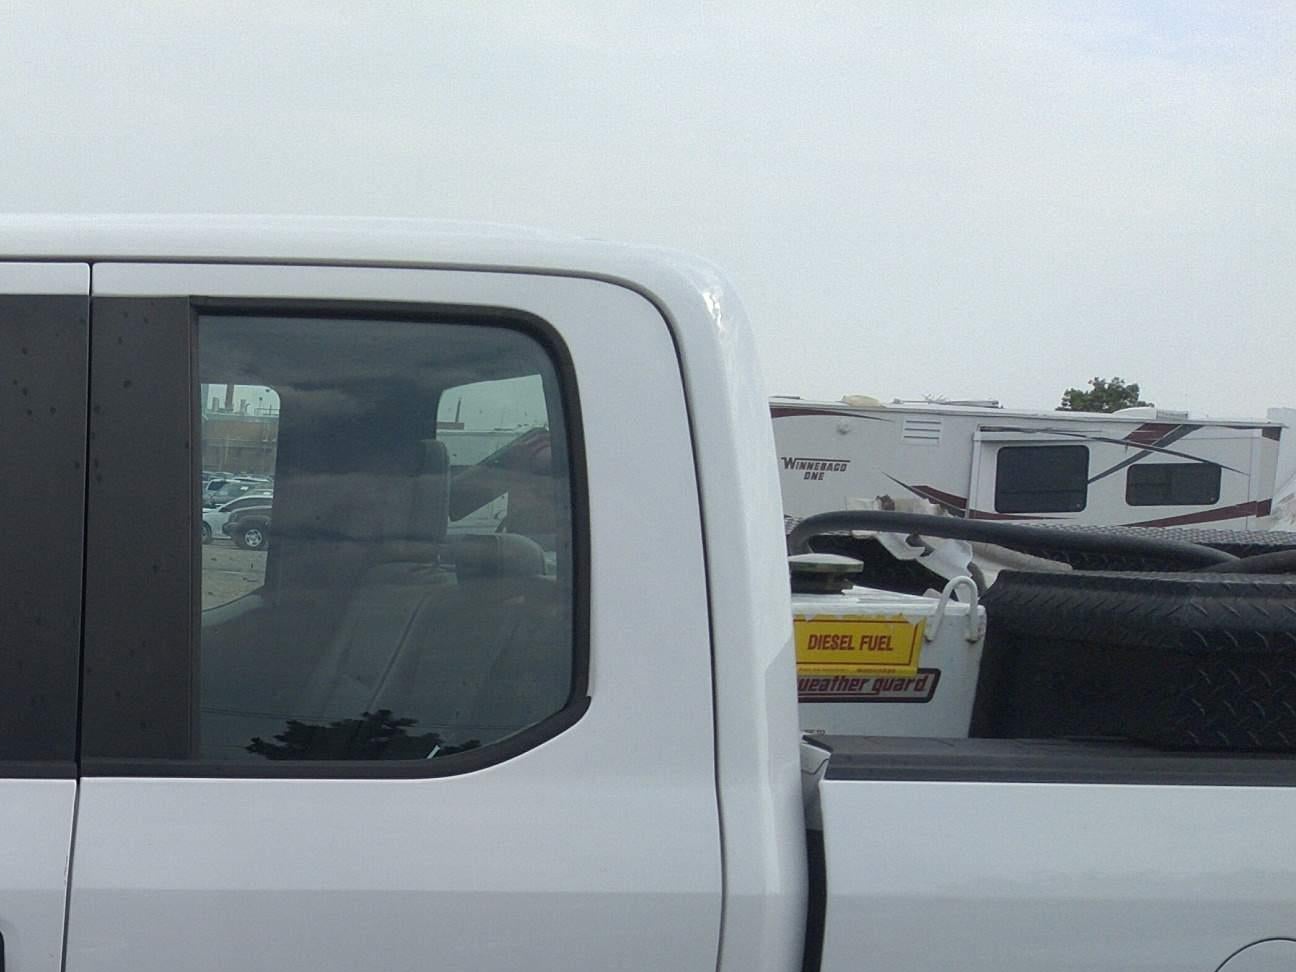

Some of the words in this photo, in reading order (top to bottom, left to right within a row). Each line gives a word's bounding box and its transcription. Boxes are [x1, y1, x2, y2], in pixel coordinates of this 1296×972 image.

[803, 471, 825, 481] ONE
[807, 634, 855, 650] DIESEL
[859, 635, 893, 651] FUEL
[872, 673, 929, 692] guard
